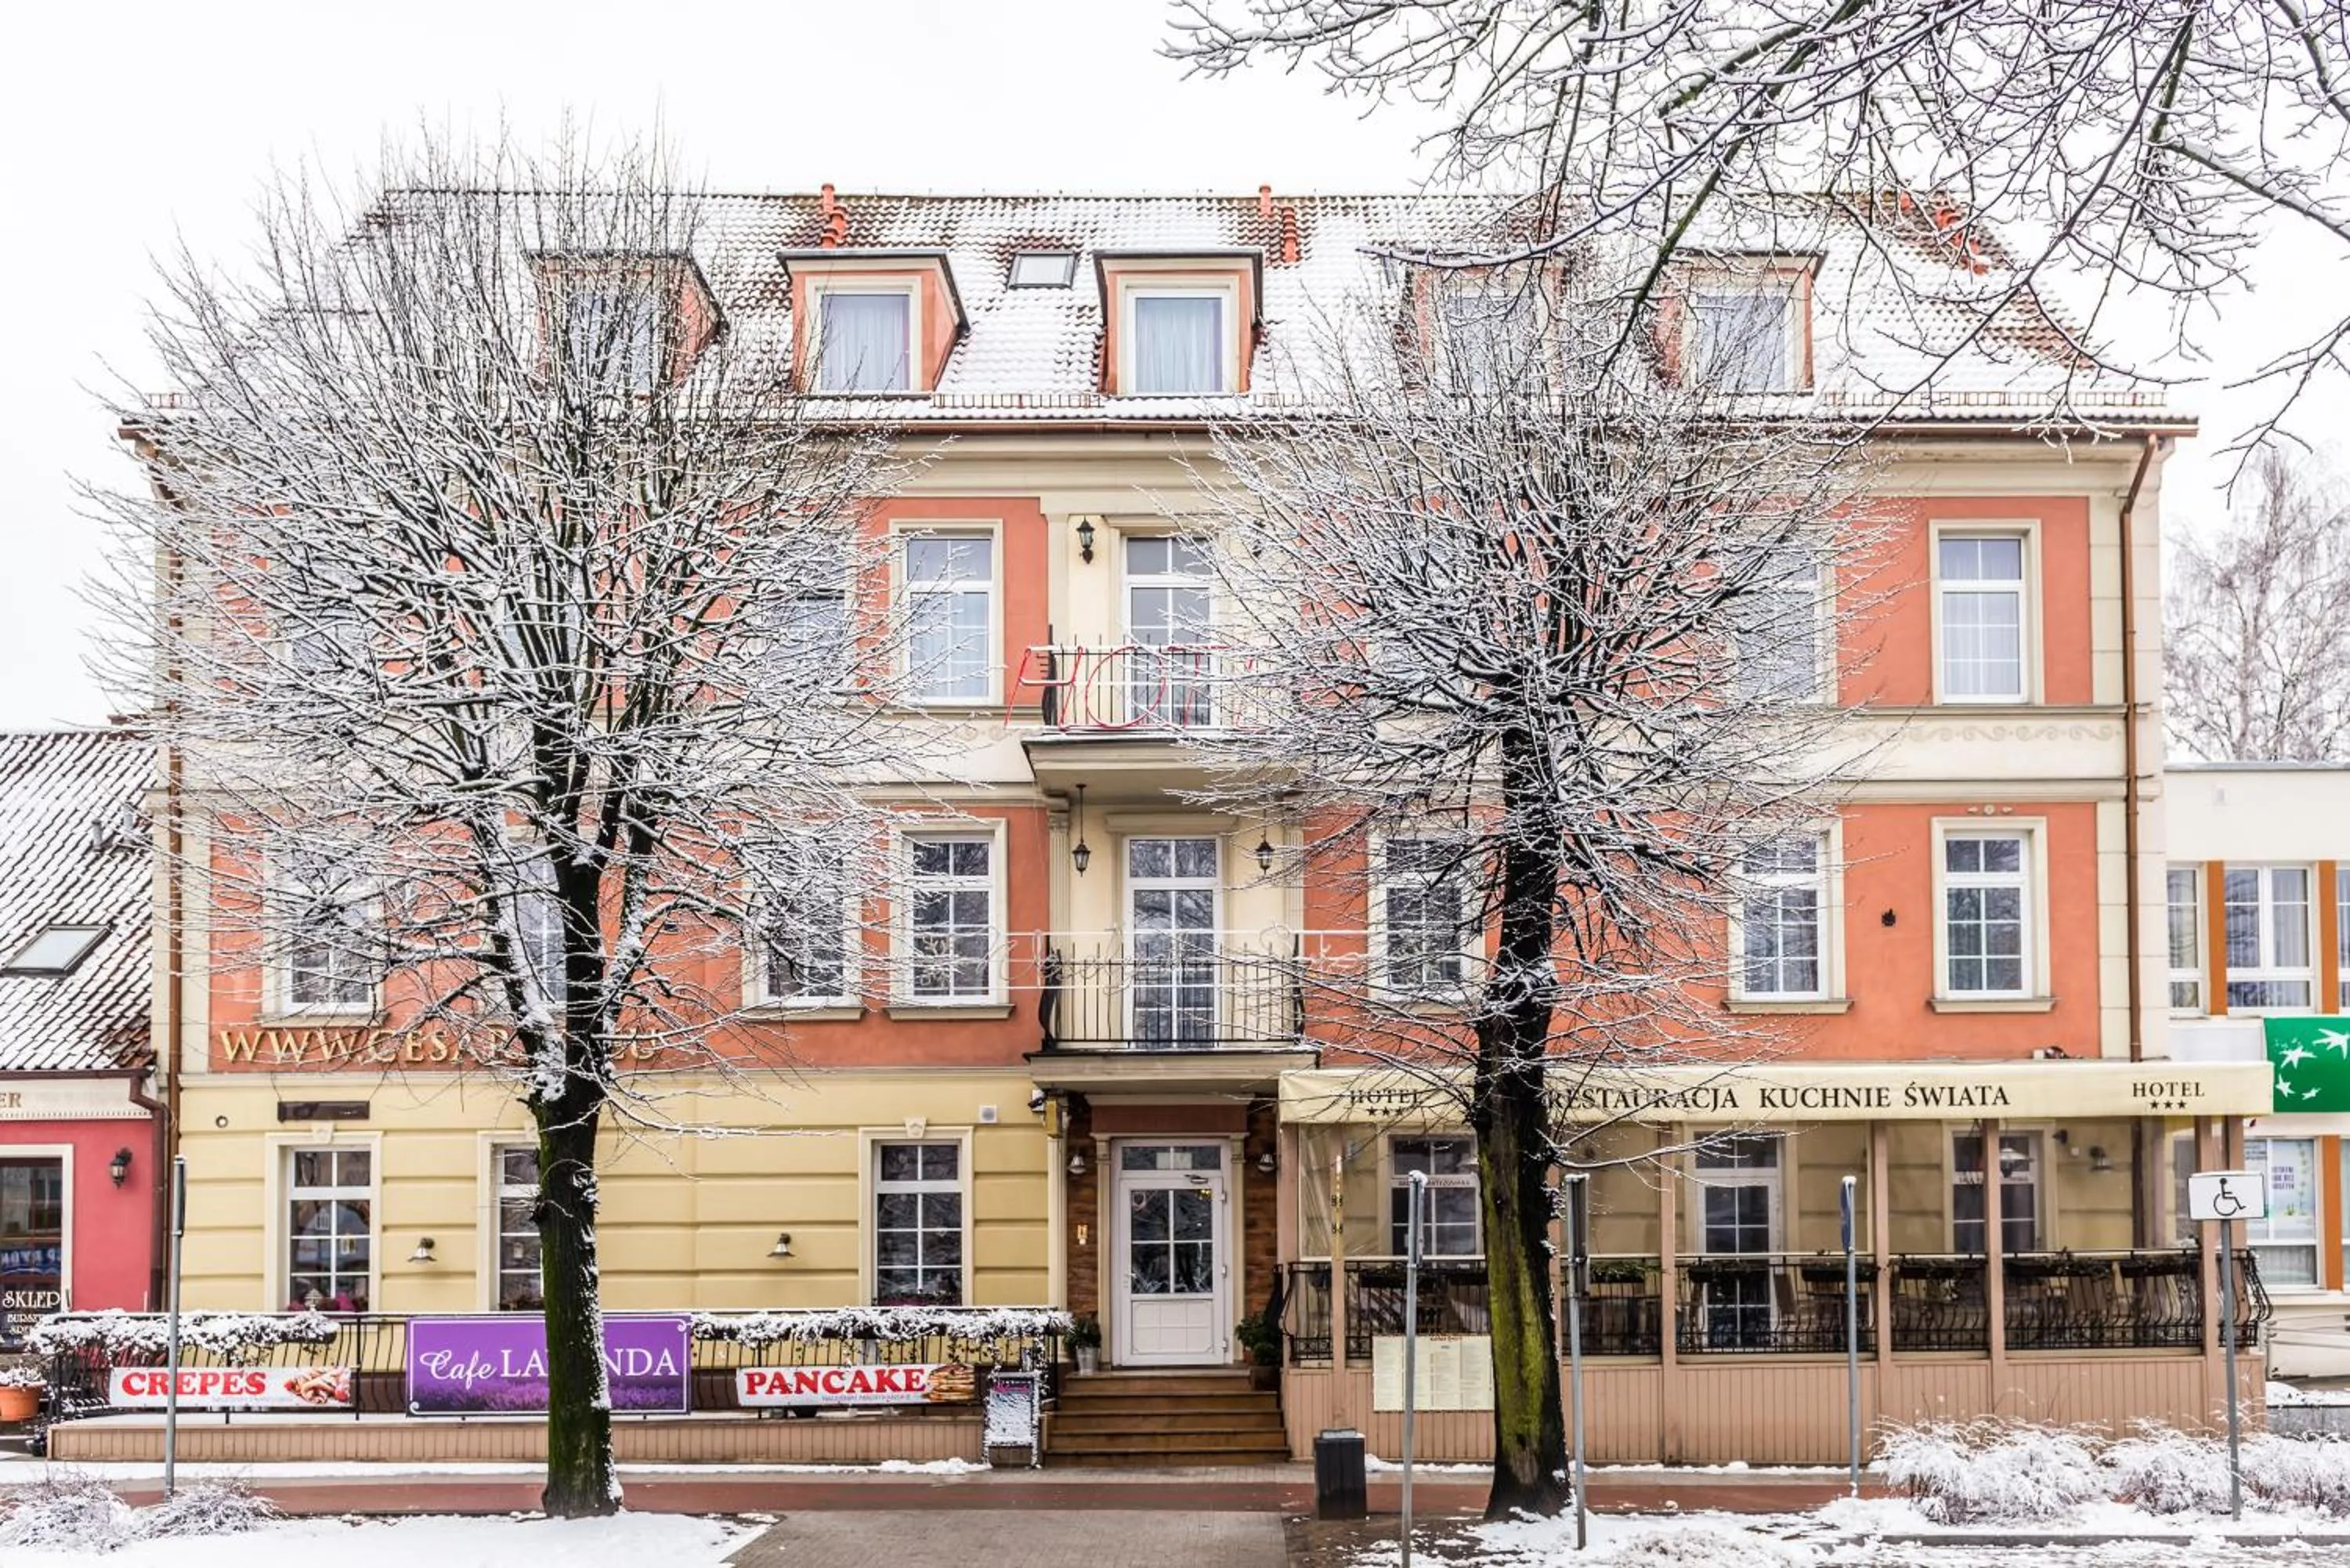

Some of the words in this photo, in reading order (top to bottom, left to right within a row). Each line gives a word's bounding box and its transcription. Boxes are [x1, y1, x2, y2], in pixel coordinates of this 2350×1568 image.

[1349, 1089, 1421, 1104] HOTEL
[1548, 1087, 1739, 1112] RESTAURACJA
[1759, 1086, 1892, 1108] KUCHNIE
[1904, 1082, 2010, 1107] ŚWIATA
[2132, 1081, 2205, 1097] HOTEL
[2, 1290, 60, 1309] SKLEP
[419, 1349, 497, 1390] Cafe
[500, 1347, 680, 1378] LANDA
[121, 1371, 266, 1396] CREPES
[744, 1368, 926, 1395] PANCAKE
